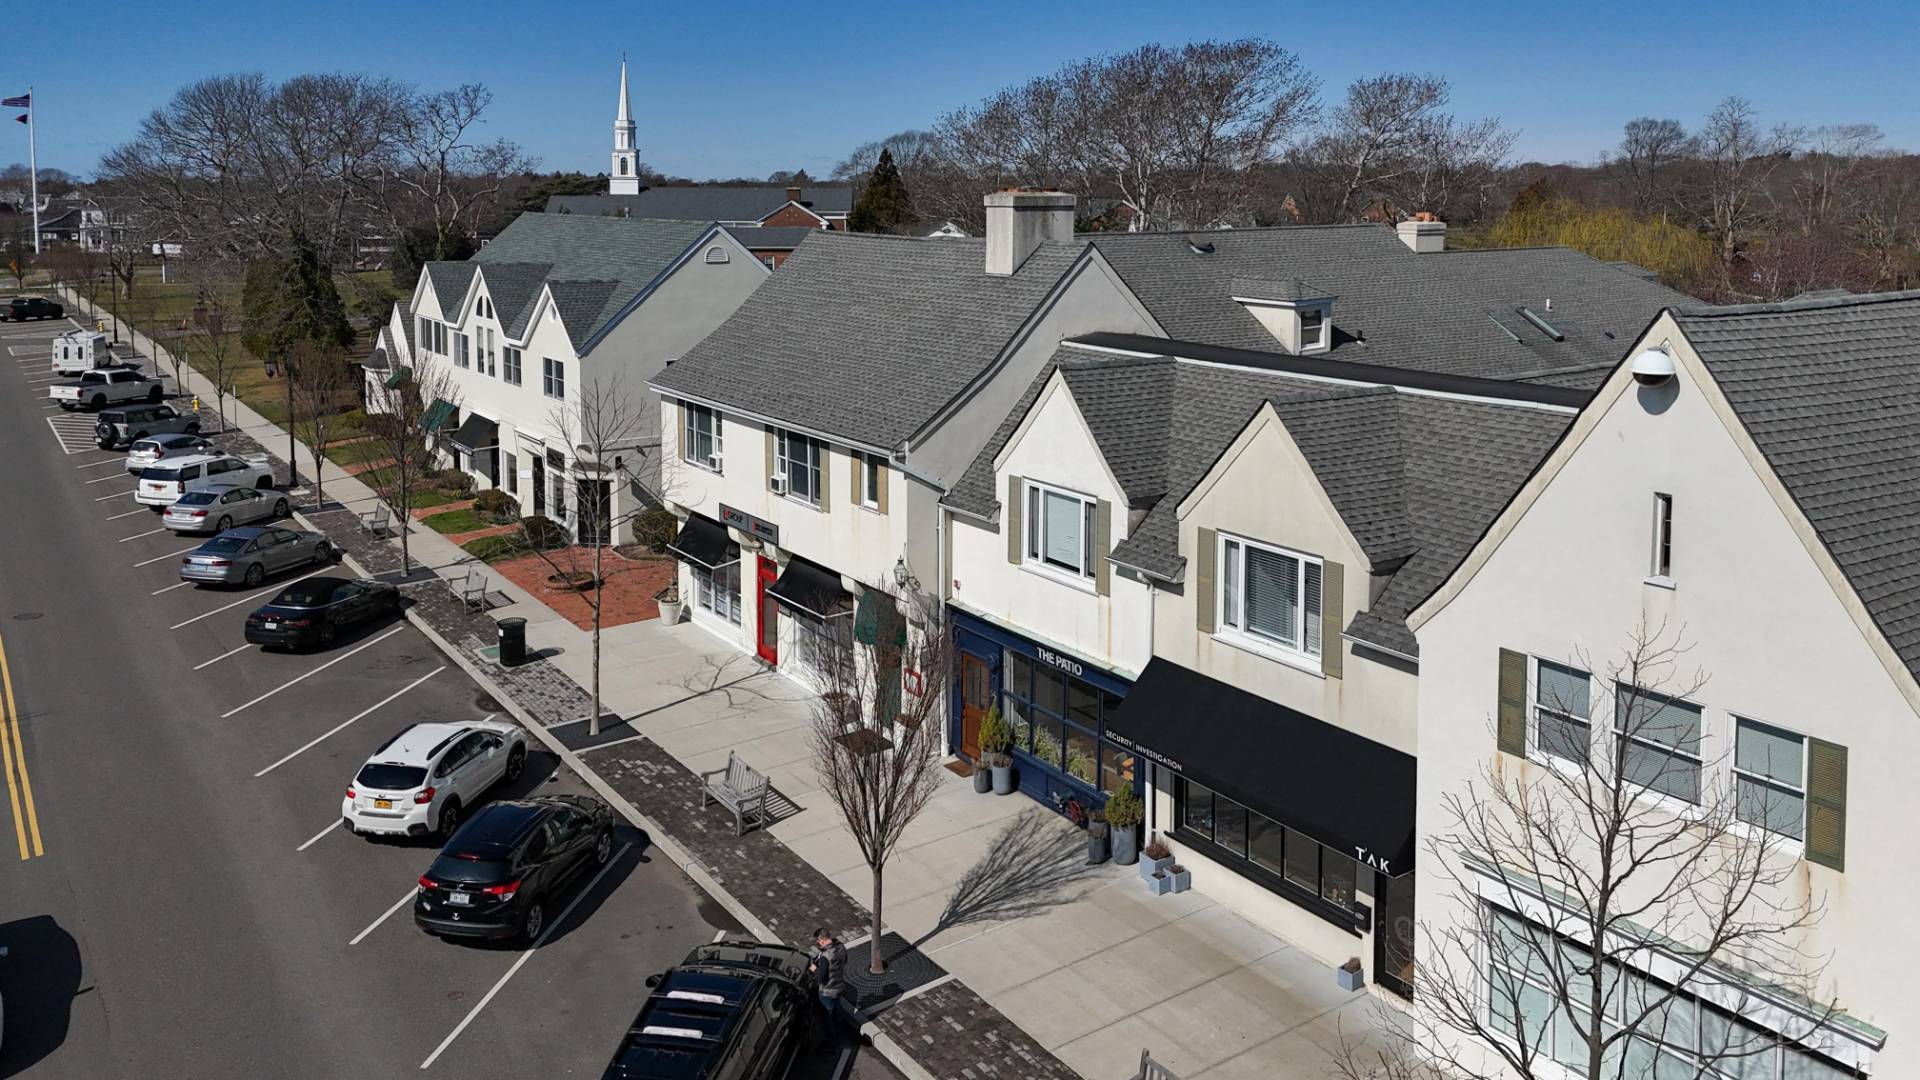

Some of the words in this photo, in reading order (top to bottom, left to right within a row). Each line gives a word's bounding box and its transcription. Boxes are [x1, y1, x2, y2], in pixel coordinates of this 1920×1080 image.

[1036, 646, 1055, 665] THE
[1055, 655, 1083, 676] PATIO
[1106, 730, 1132, 748] SECURITY
[1135, 743, 1182, 771] INVESTIGATION
